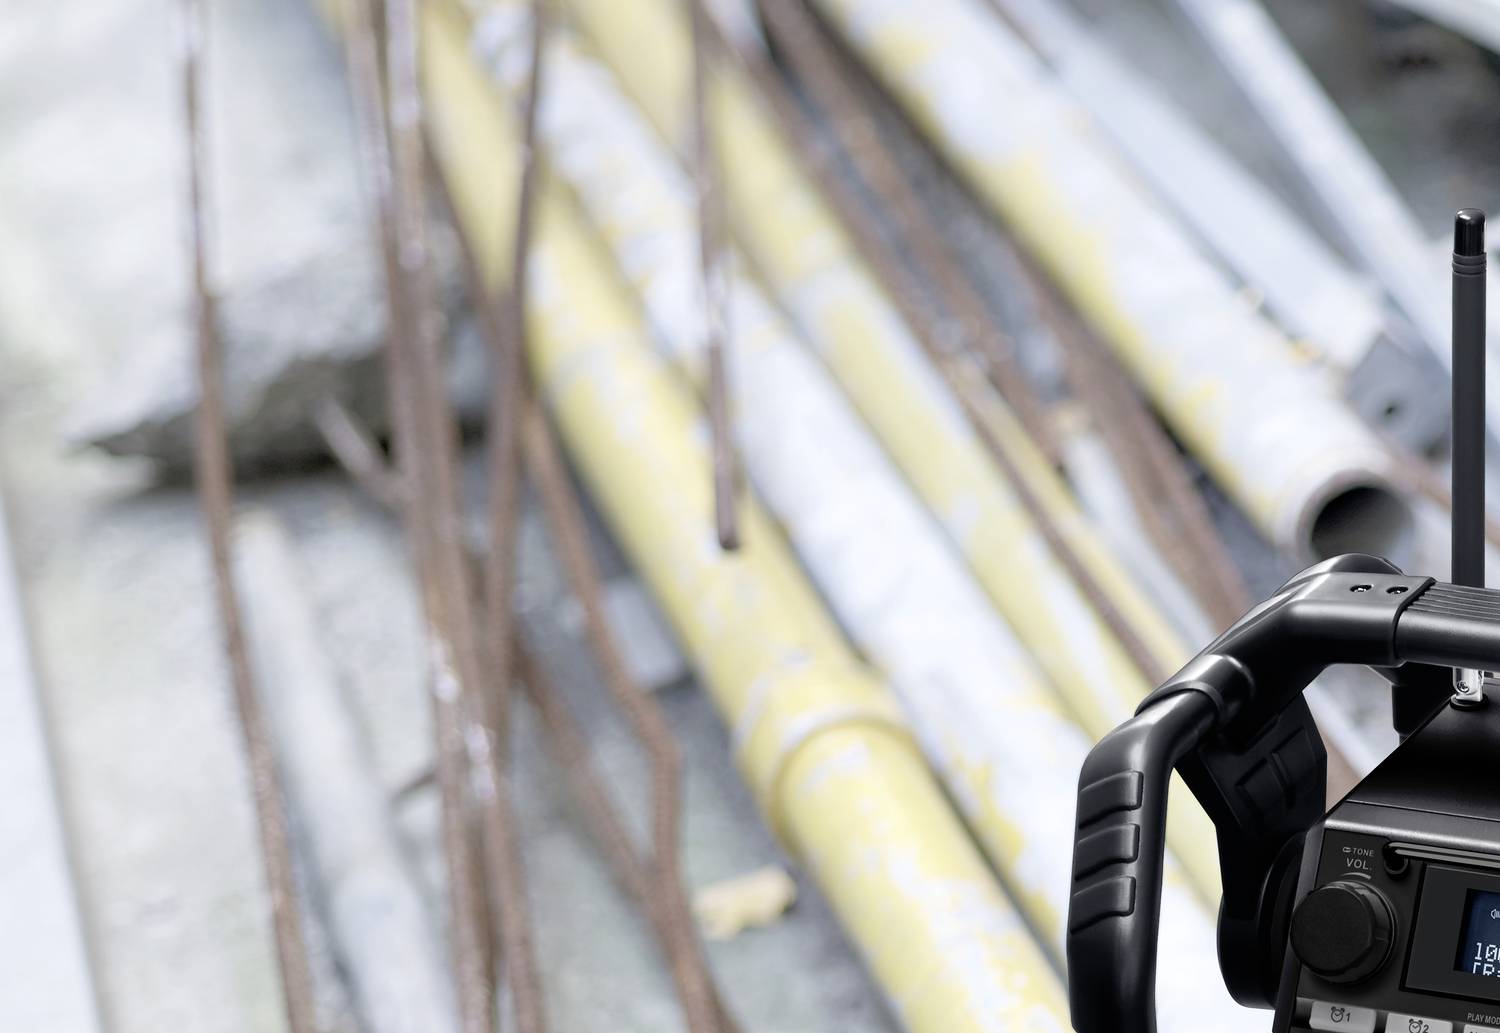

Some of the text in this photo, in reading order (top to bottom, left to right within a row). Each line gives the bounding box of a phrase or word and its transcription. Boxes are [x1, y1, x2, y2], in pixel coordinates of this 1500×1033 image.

[1353, 847, 1375, 857] TONE
[1467, 1012, 1485, 1022] PLAY
[1422, 1024, 1429, 1033] 2
